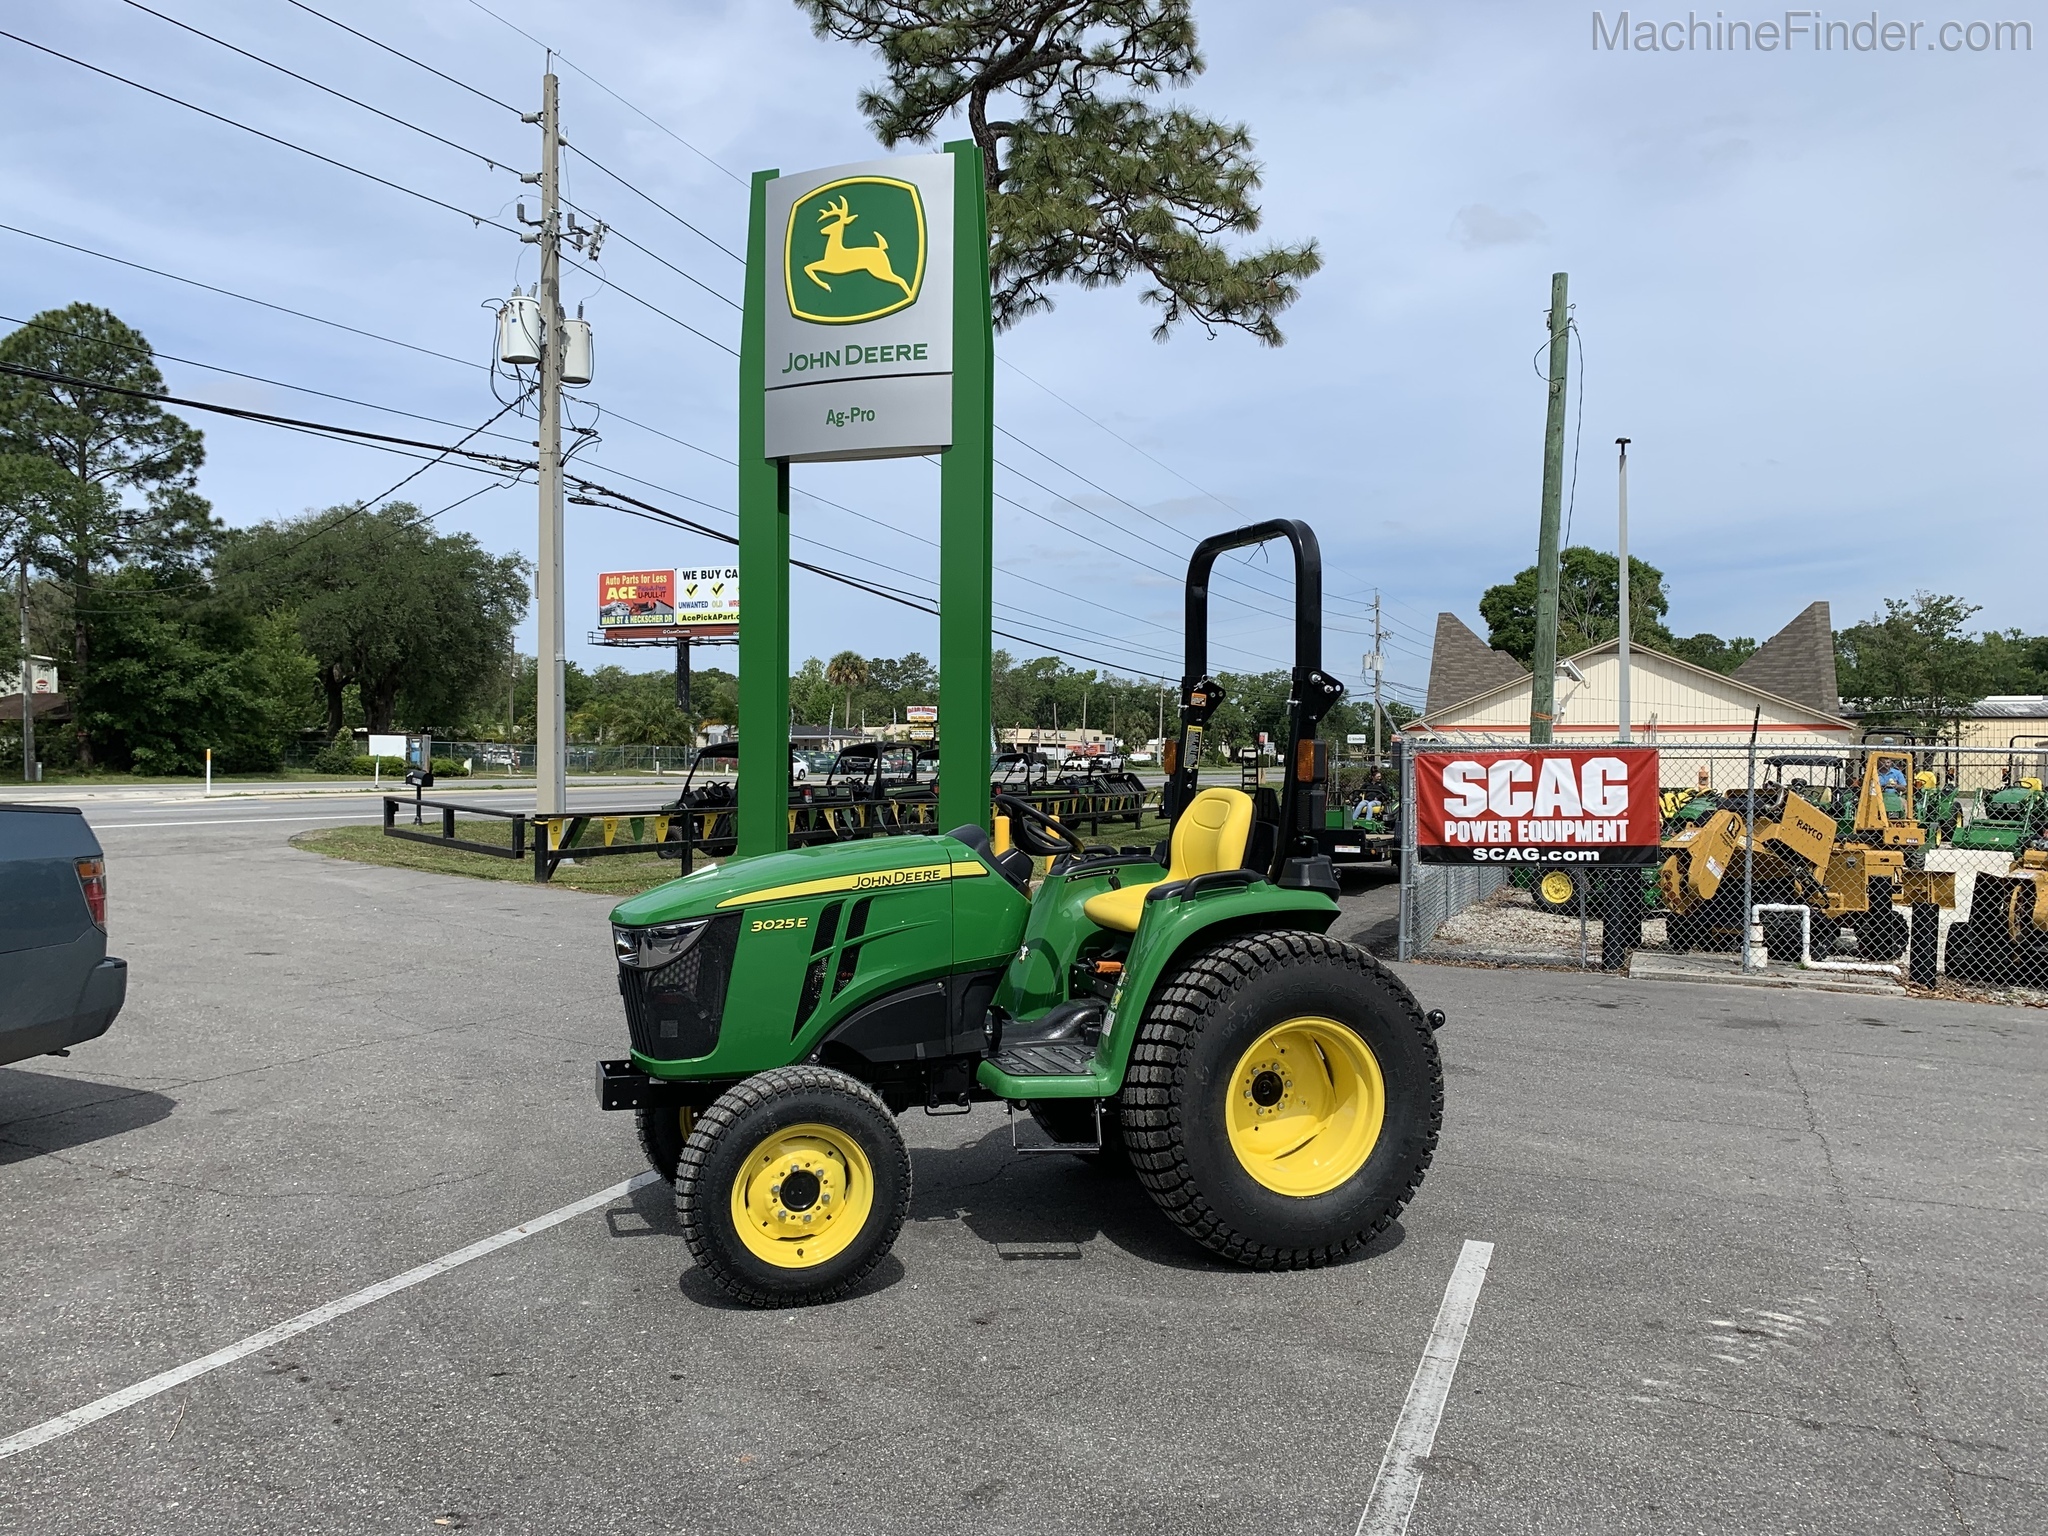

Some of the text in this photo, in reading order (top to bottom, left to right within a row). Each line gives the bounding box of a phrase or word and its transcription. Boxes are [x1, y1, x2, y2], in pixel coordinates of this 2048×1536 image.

[782, 343, 928, 374] JOHN DEERE
[826, 407, 876, 427] Ag-Pro
[605, 573, 668, 586] Auto Parts for Less
[682, 570, 698, 581] WE
[700, 569, 722, 580] BUY
[606, 586, 638, 600] ACE
[678, 601, 709, 609] UNWANTED
[601, 616, 616, 625] MAIN
[616, 615, 624, 624] ST
[629, 614, 664, 624] HECKSCHER
[664, 614, 673, 623] DR
[1442, 757, 1629, 818] SCAG
[1444, 819, 1630, 843] POWER EQUIPMENT
[1796, 819, 1823, 841] RAYCO
[1473, 848, 1600, 862] SCAG.com
[852, 869, 941, 889] JOHN DEERE
